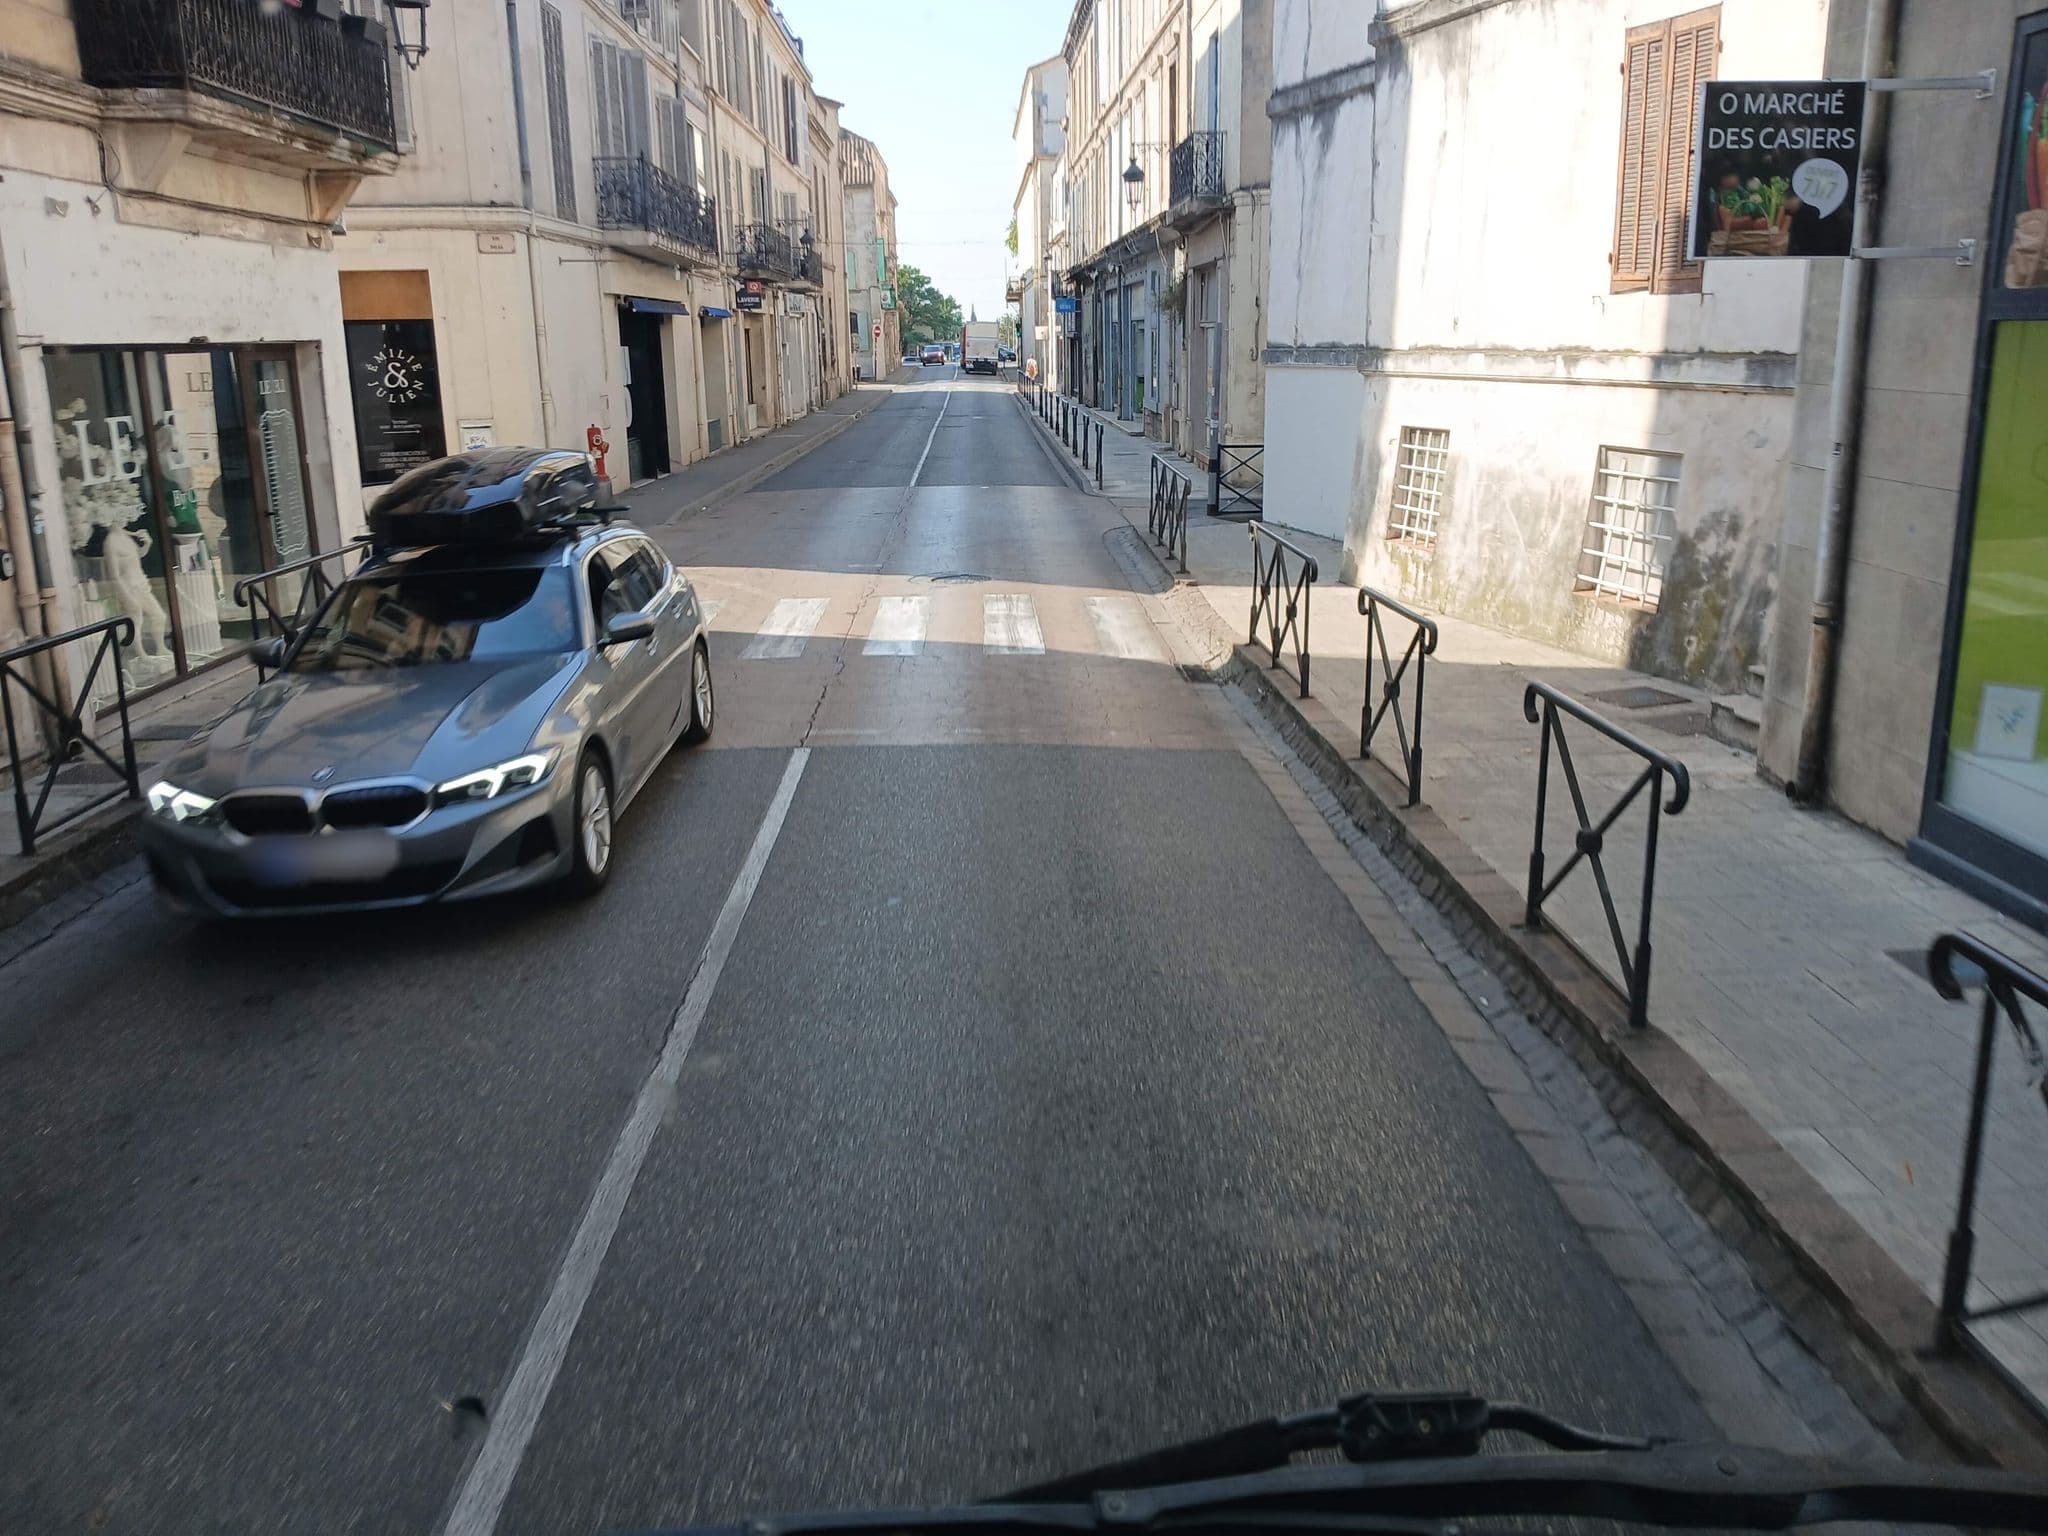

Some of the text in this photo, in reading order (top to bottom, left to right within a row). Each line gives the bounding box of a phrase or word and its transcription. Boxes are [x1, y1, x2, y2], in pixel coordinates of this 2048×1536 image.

[1719, 89, 1845, 115] O MARCHÉ
[1708, 127, 1856, 150] DES CASIERS
[366, 348, 423, 372] ÉMILIE
[384, 362, 409, 388] &
[367, 380, 424, 403] JULIEN
